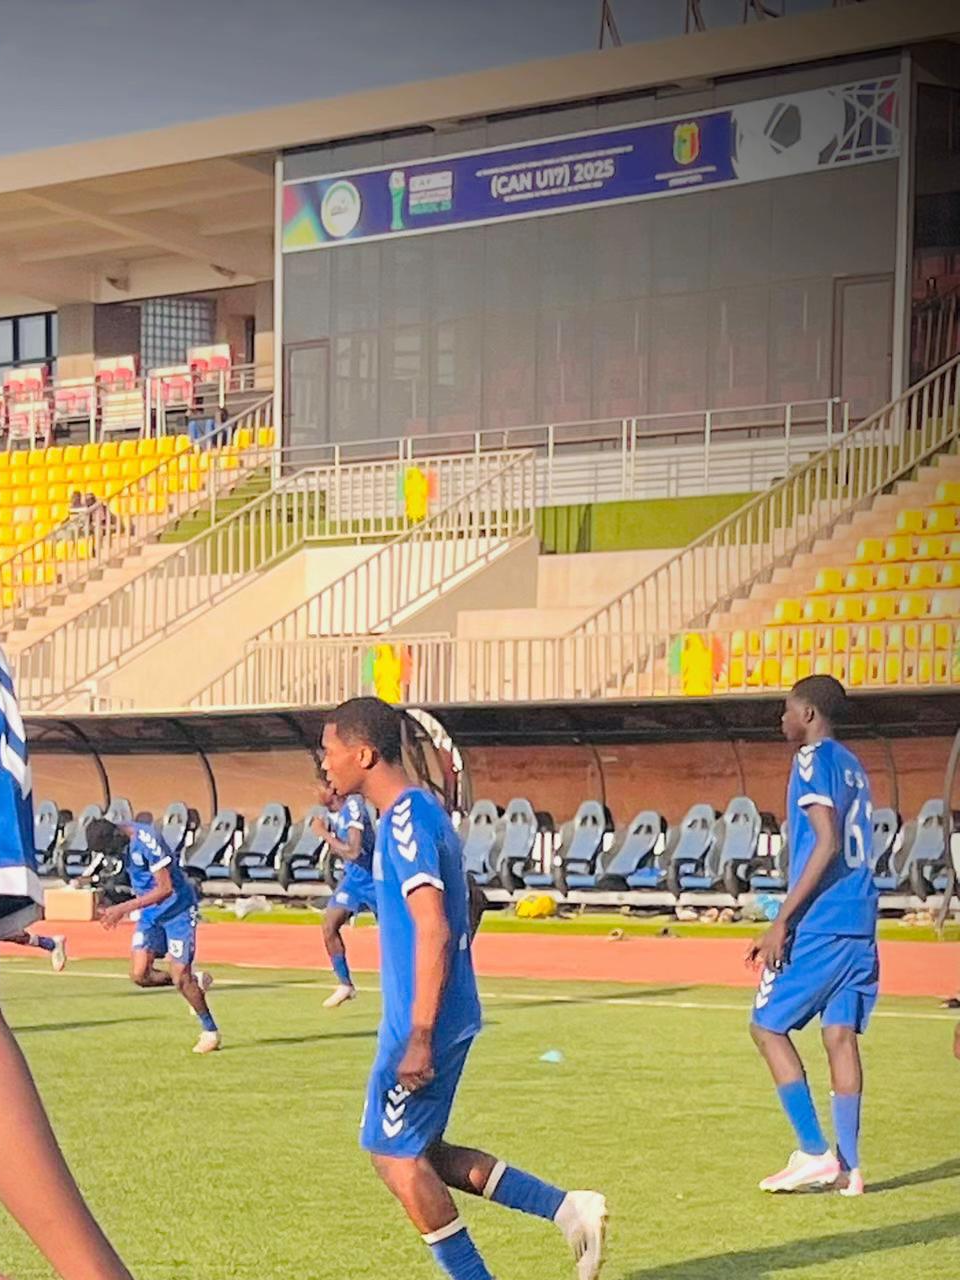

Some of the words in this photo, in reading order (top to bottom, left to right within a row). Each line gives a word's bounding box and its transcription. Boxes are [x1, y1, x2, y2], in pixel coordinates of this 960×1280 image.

[491, 171, 533, 198] (CAN
[535, 163, 570, 189] U17)
[574, 158, 615, 183] 2025
